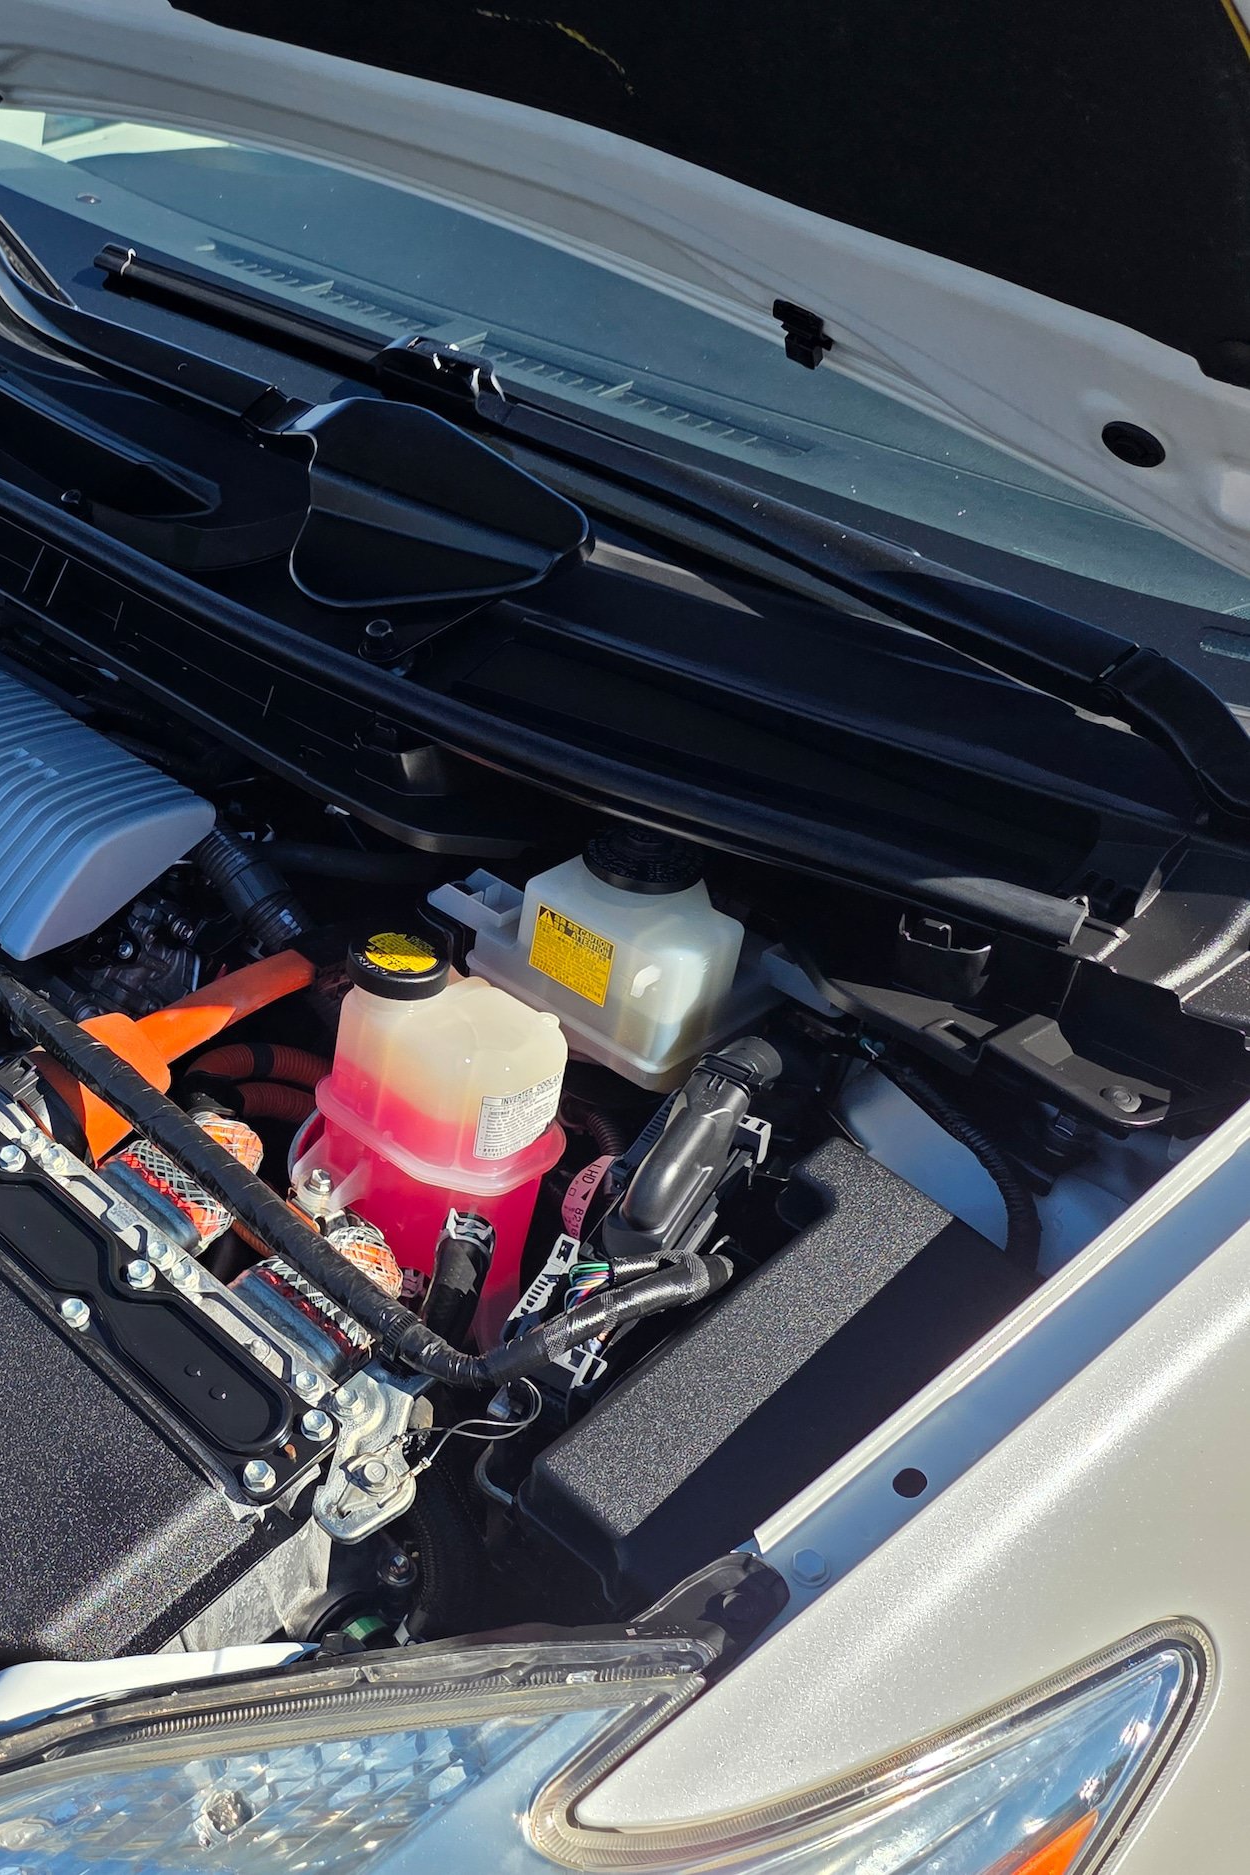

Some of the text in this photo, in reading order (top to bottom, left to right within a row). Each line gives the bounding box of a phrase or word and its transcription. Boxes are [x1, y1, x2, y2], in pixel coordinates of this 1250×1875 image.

[571, 931, 610, 957] ATTENTION
[580, 928, 611, 950] CAUTION
[501, 1087, 534, 1106] INVERTER
[581, 1164, 602, 1185] LHD
